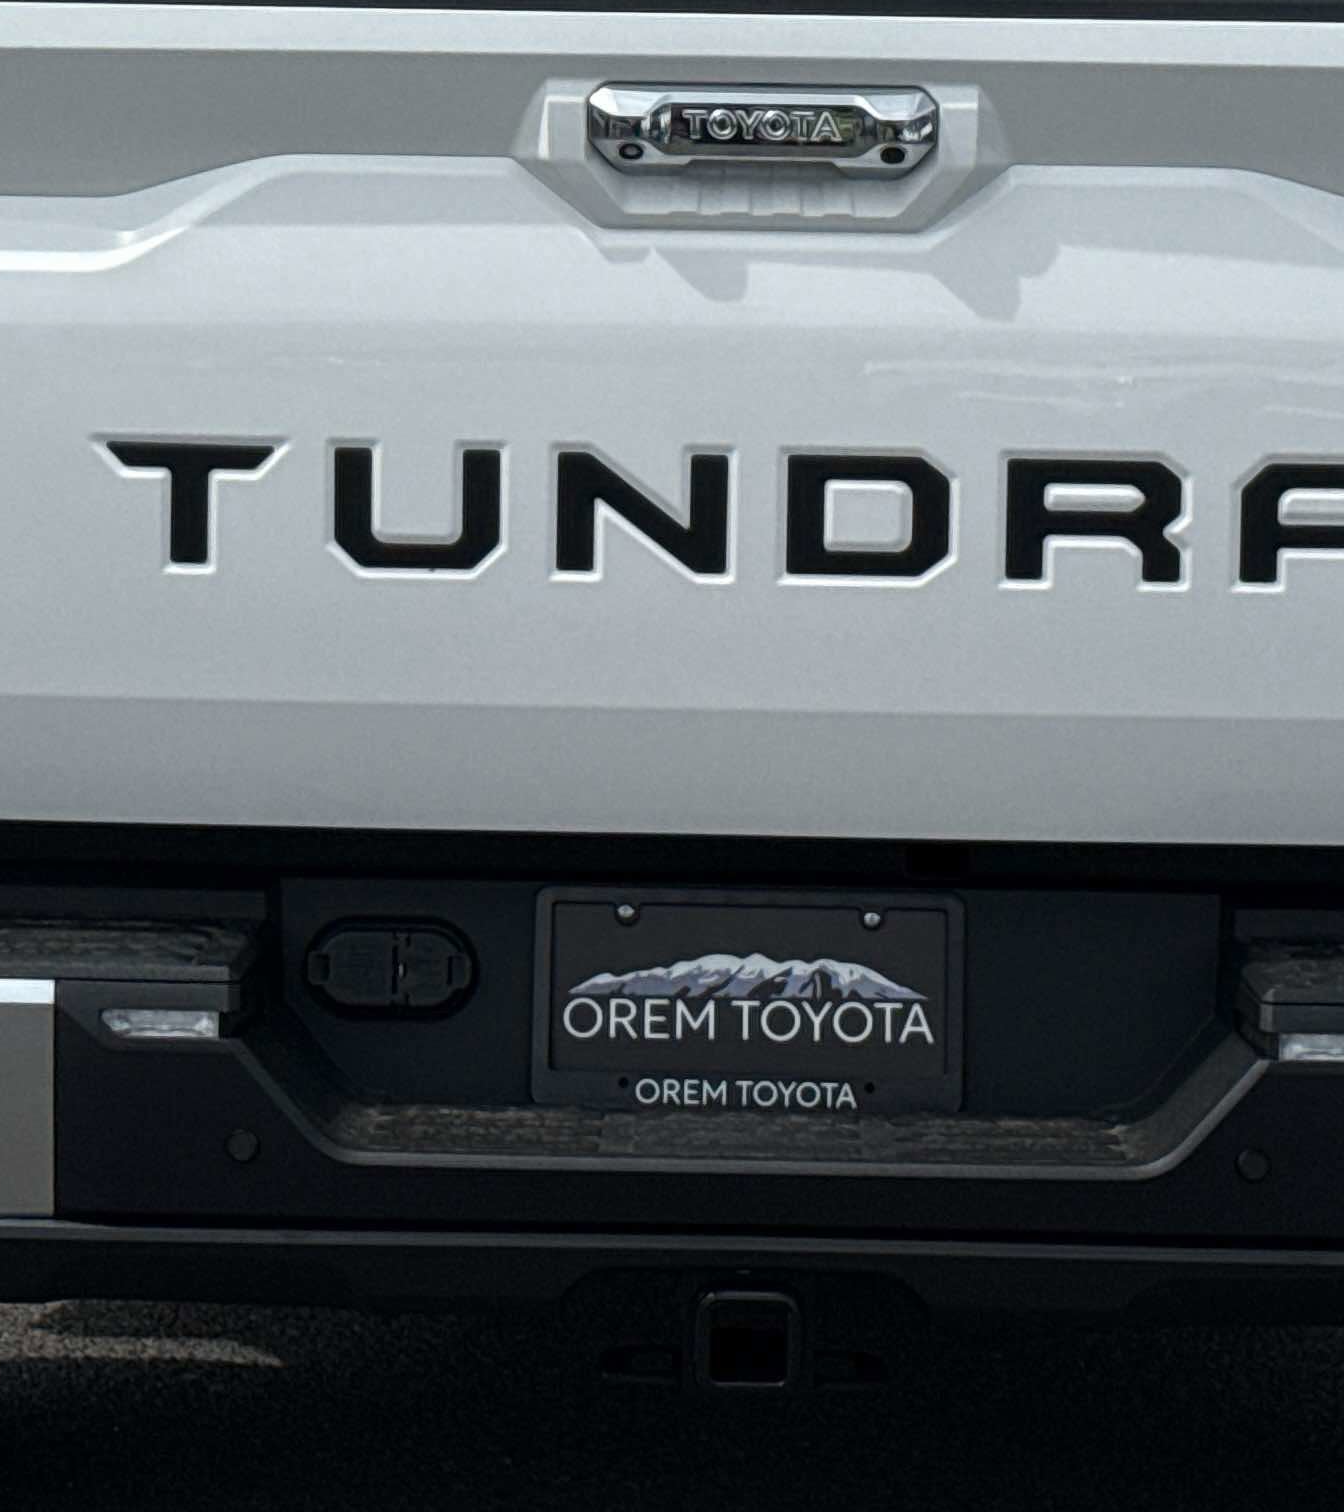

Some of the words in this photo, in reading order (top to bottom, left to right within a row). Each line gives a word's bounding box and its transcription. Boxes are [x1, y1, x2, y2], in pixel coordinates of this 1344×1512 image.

[682, 108, 843, 142] TOYOTA
[562, 996, 716, 1040] OREM
[730, 999, 935, 1045] TOYOTA
[634, 1078, 728, 1106] OREM
[735, 1079, 857, 1109] TOYOTA
